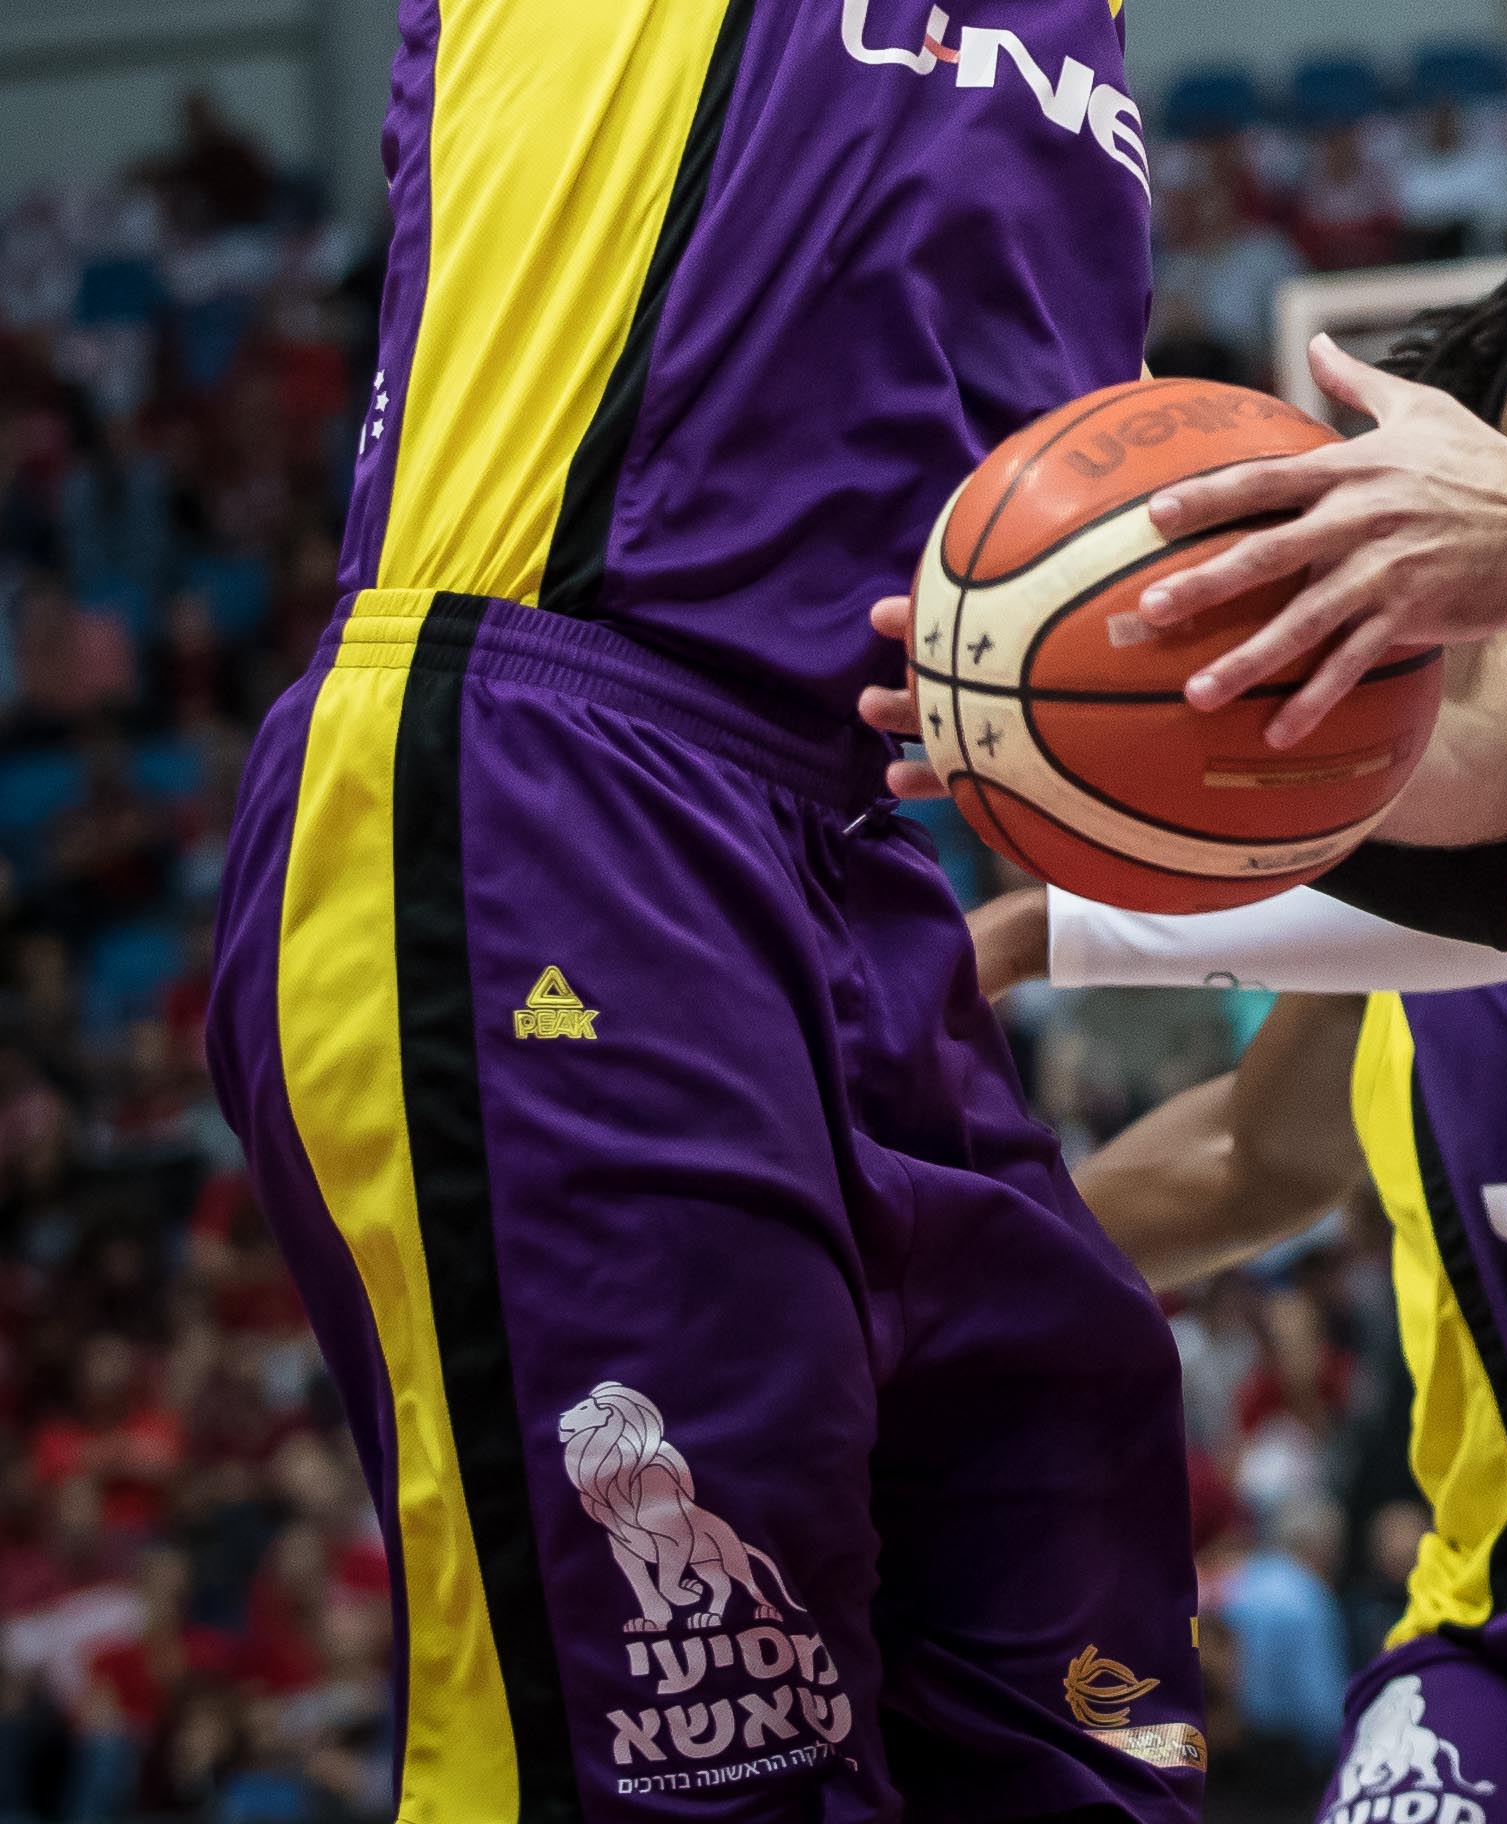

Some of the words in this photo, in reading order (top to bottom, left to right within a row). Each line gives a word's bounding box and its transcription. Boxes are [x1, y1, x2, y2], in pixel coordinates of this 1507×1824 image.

[513, 1009, 601, 1040] PEAK
[625, 1626, 839, 1695] מסיעי
[606, 1684, 852, 1765] שאשא
[617, 1771, 691, 1795] בדרכים
[696, 1754, 787, 1787] הראשונה
